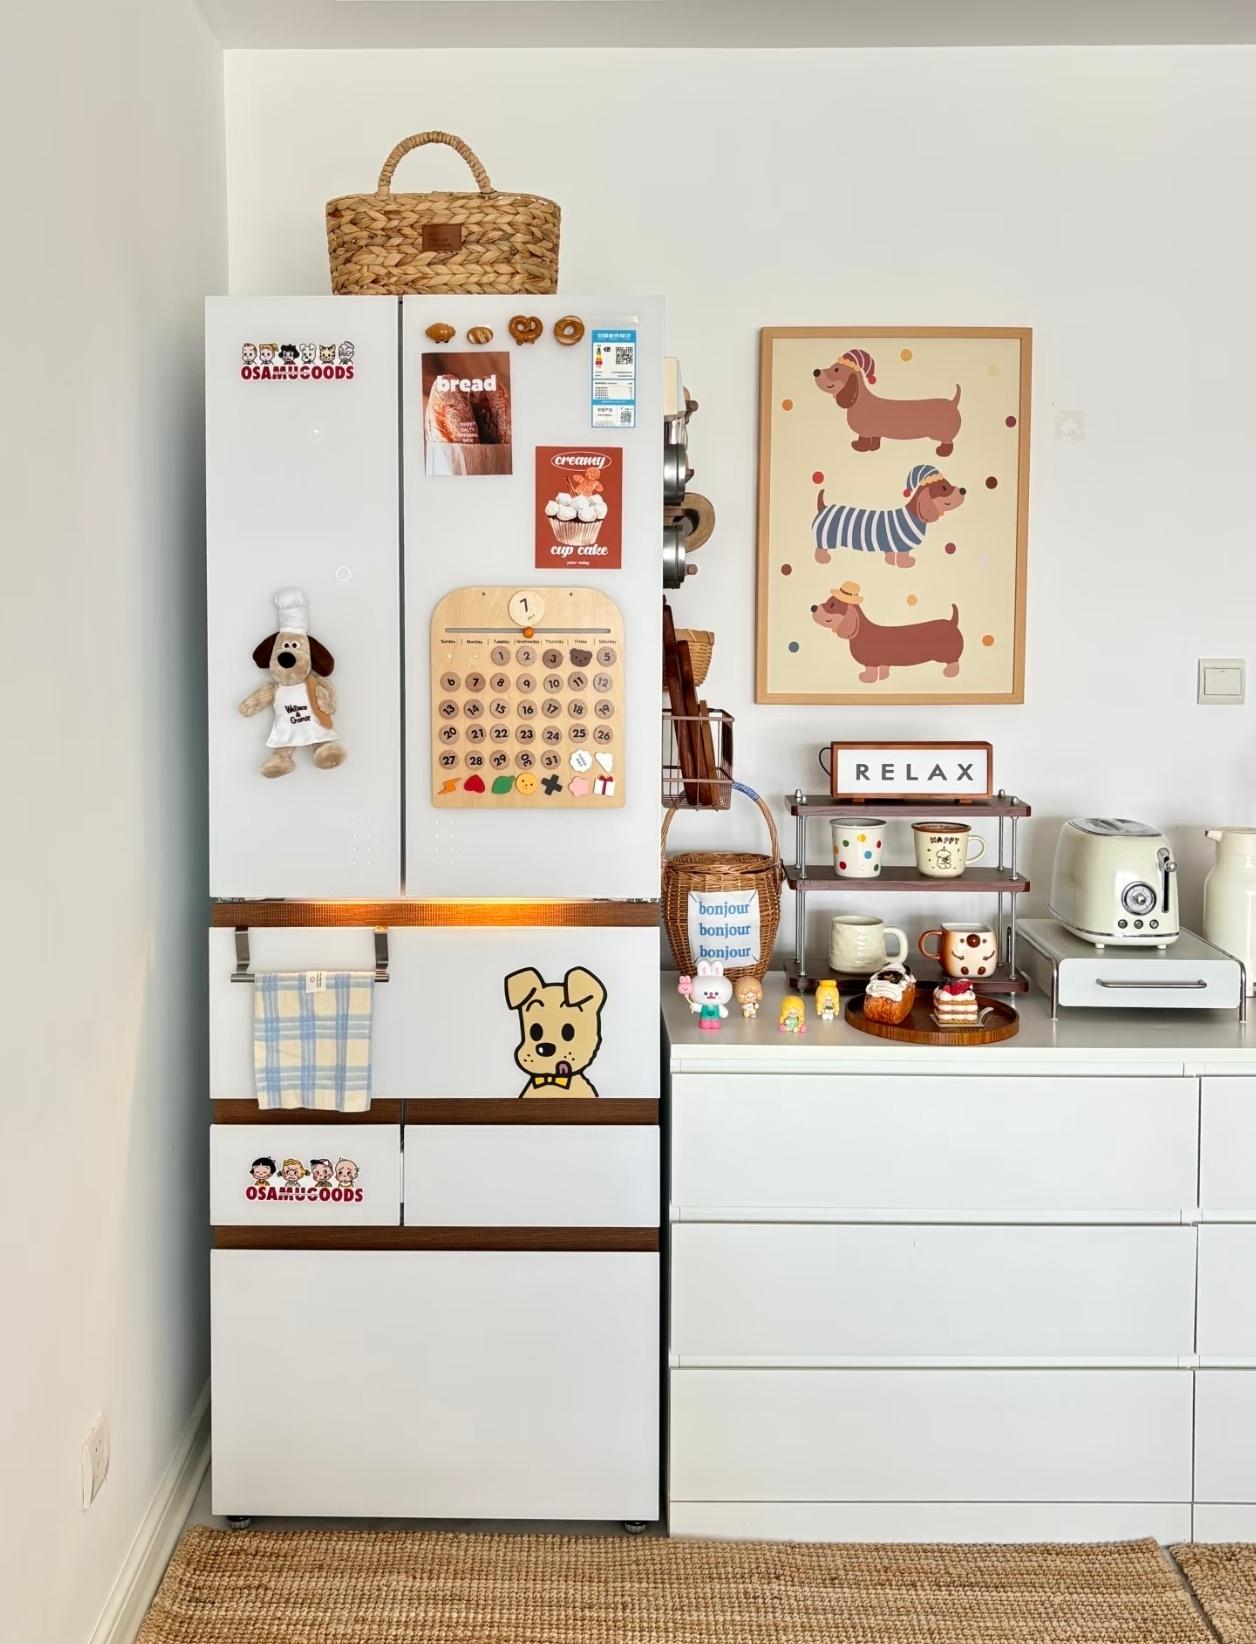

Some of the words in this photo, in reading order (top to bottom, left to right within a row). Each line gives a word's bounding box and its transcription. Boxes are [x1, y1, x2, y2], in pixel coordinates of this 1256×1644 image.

[241, 366, 354, 380] OSAMUGOODS
[436, 374, 496, 392] bread
[554, 456, 605, 468] creamy
[550, 546, 574, 558] cup
[578, 544, 609, 556] cake
[498, 652, 503, 660] 1
[550, 654, 557, 663] 3
[604, 653, 610, 661] 5
[447, 677, 455, 685] 6
[472, 678, 479, 686] 7
[497, 678, 504, 686] 8
[523, 679, 530, 688] 9
[548, 679, 560, 688] 10
[573, 676, 584, 686] 11
[598, 677, 608, 686] 12
[443, 704, 455, 715] 13
[468, 704, 479, 715] 14
[495, 704, 506, 714] 15
[522, 706, 534, 714] 16
[547, 704, 558, 713] 17
[573, 704, 583, 714] 18
[599, 704, 610, 714] 19
[444, 727, 457, 740] 20
[472, 729, 483, 738] 21
[495, 729, 507, 738] 22
[521, 730, 533, 738] 23
[547, 731, 559, 740] 24
[573, 729, 585, 738] 25
[598, 731, 610, 740] 26
[443, 756, 456, 764] 27
[470, 757, 482, 765] 28
[494, 755, 506, 765] 29
[521, 753, 532, 766] 30
[546, 755, 558, 764] 31
[856, 764, 973, 780] RELAX
[930, 836, 960, 844] HAPPY
[699, 902, 750, 918] bonjour
[699, 923, 751, 938] bonjour
[700, 945, 751, 960] bonjour
[246, 1186, 363, 1202] OSAMUGOODS
